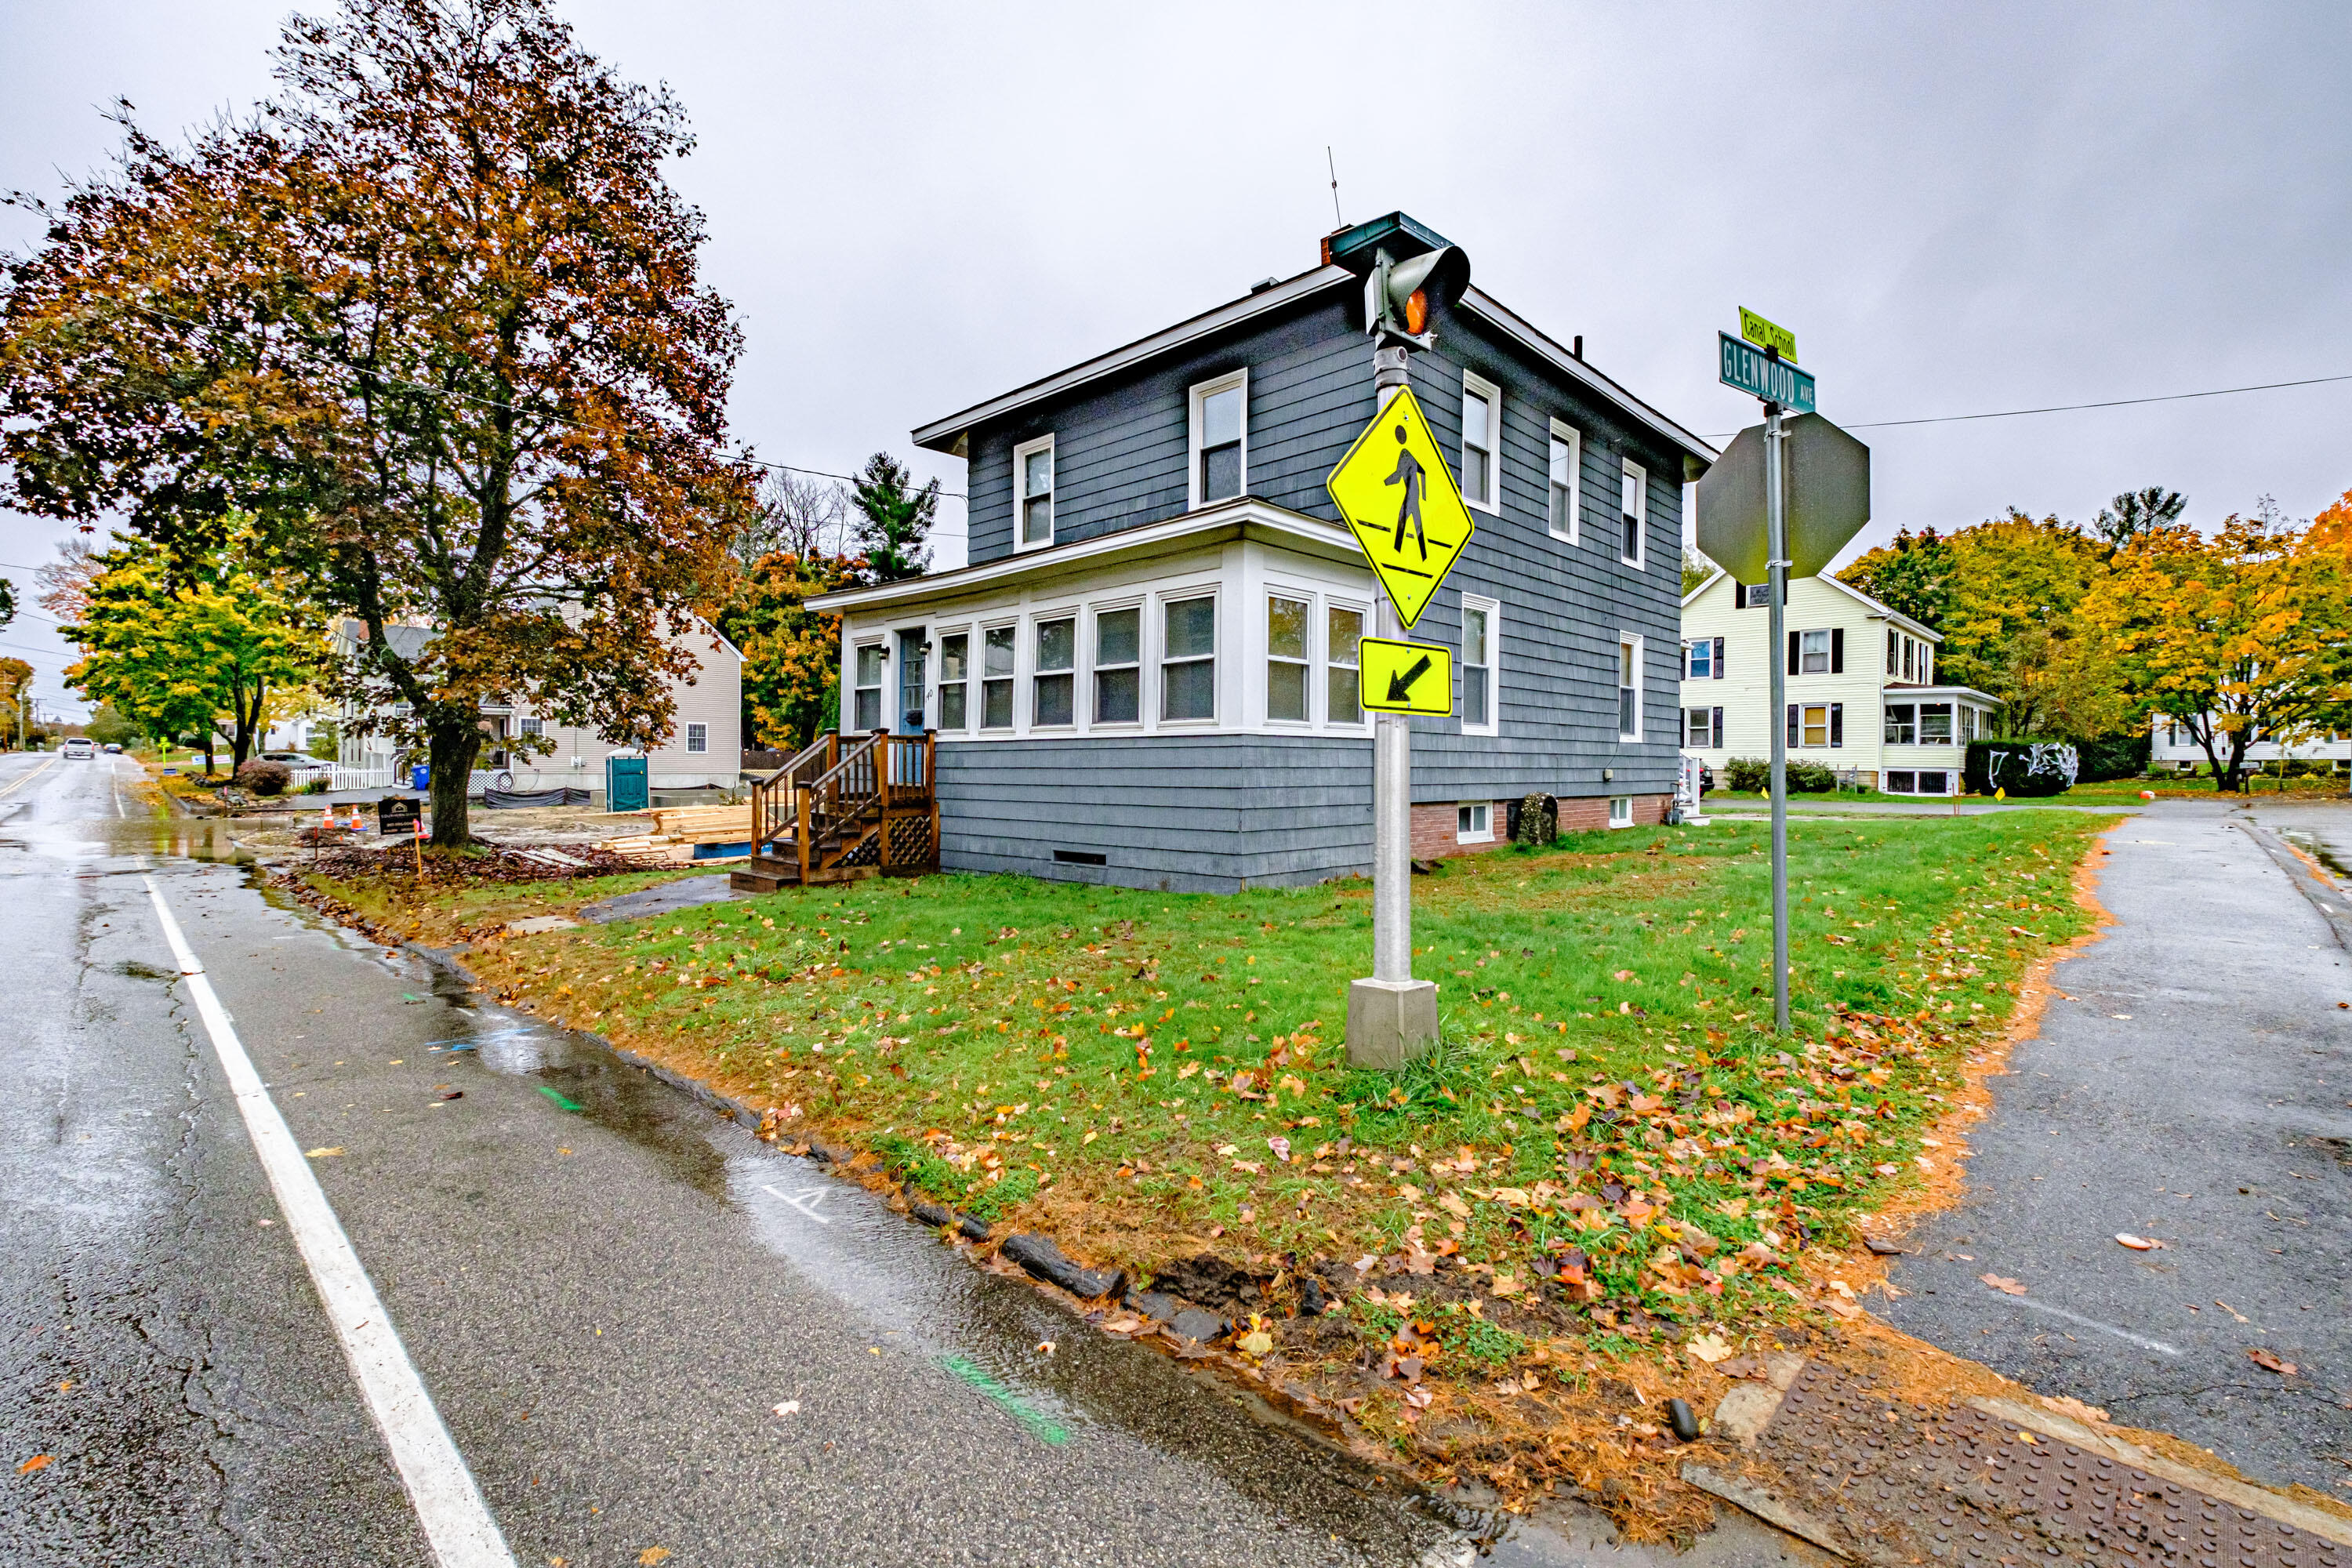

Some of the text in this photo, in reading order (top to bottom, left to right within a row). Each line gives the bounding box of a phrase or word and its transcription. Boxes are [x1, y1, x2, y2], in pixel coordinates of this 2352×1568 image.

[1744, 313, 1795, 358] Canal School
[1723, 341, 1813, 405] GLENWOOD AVE
